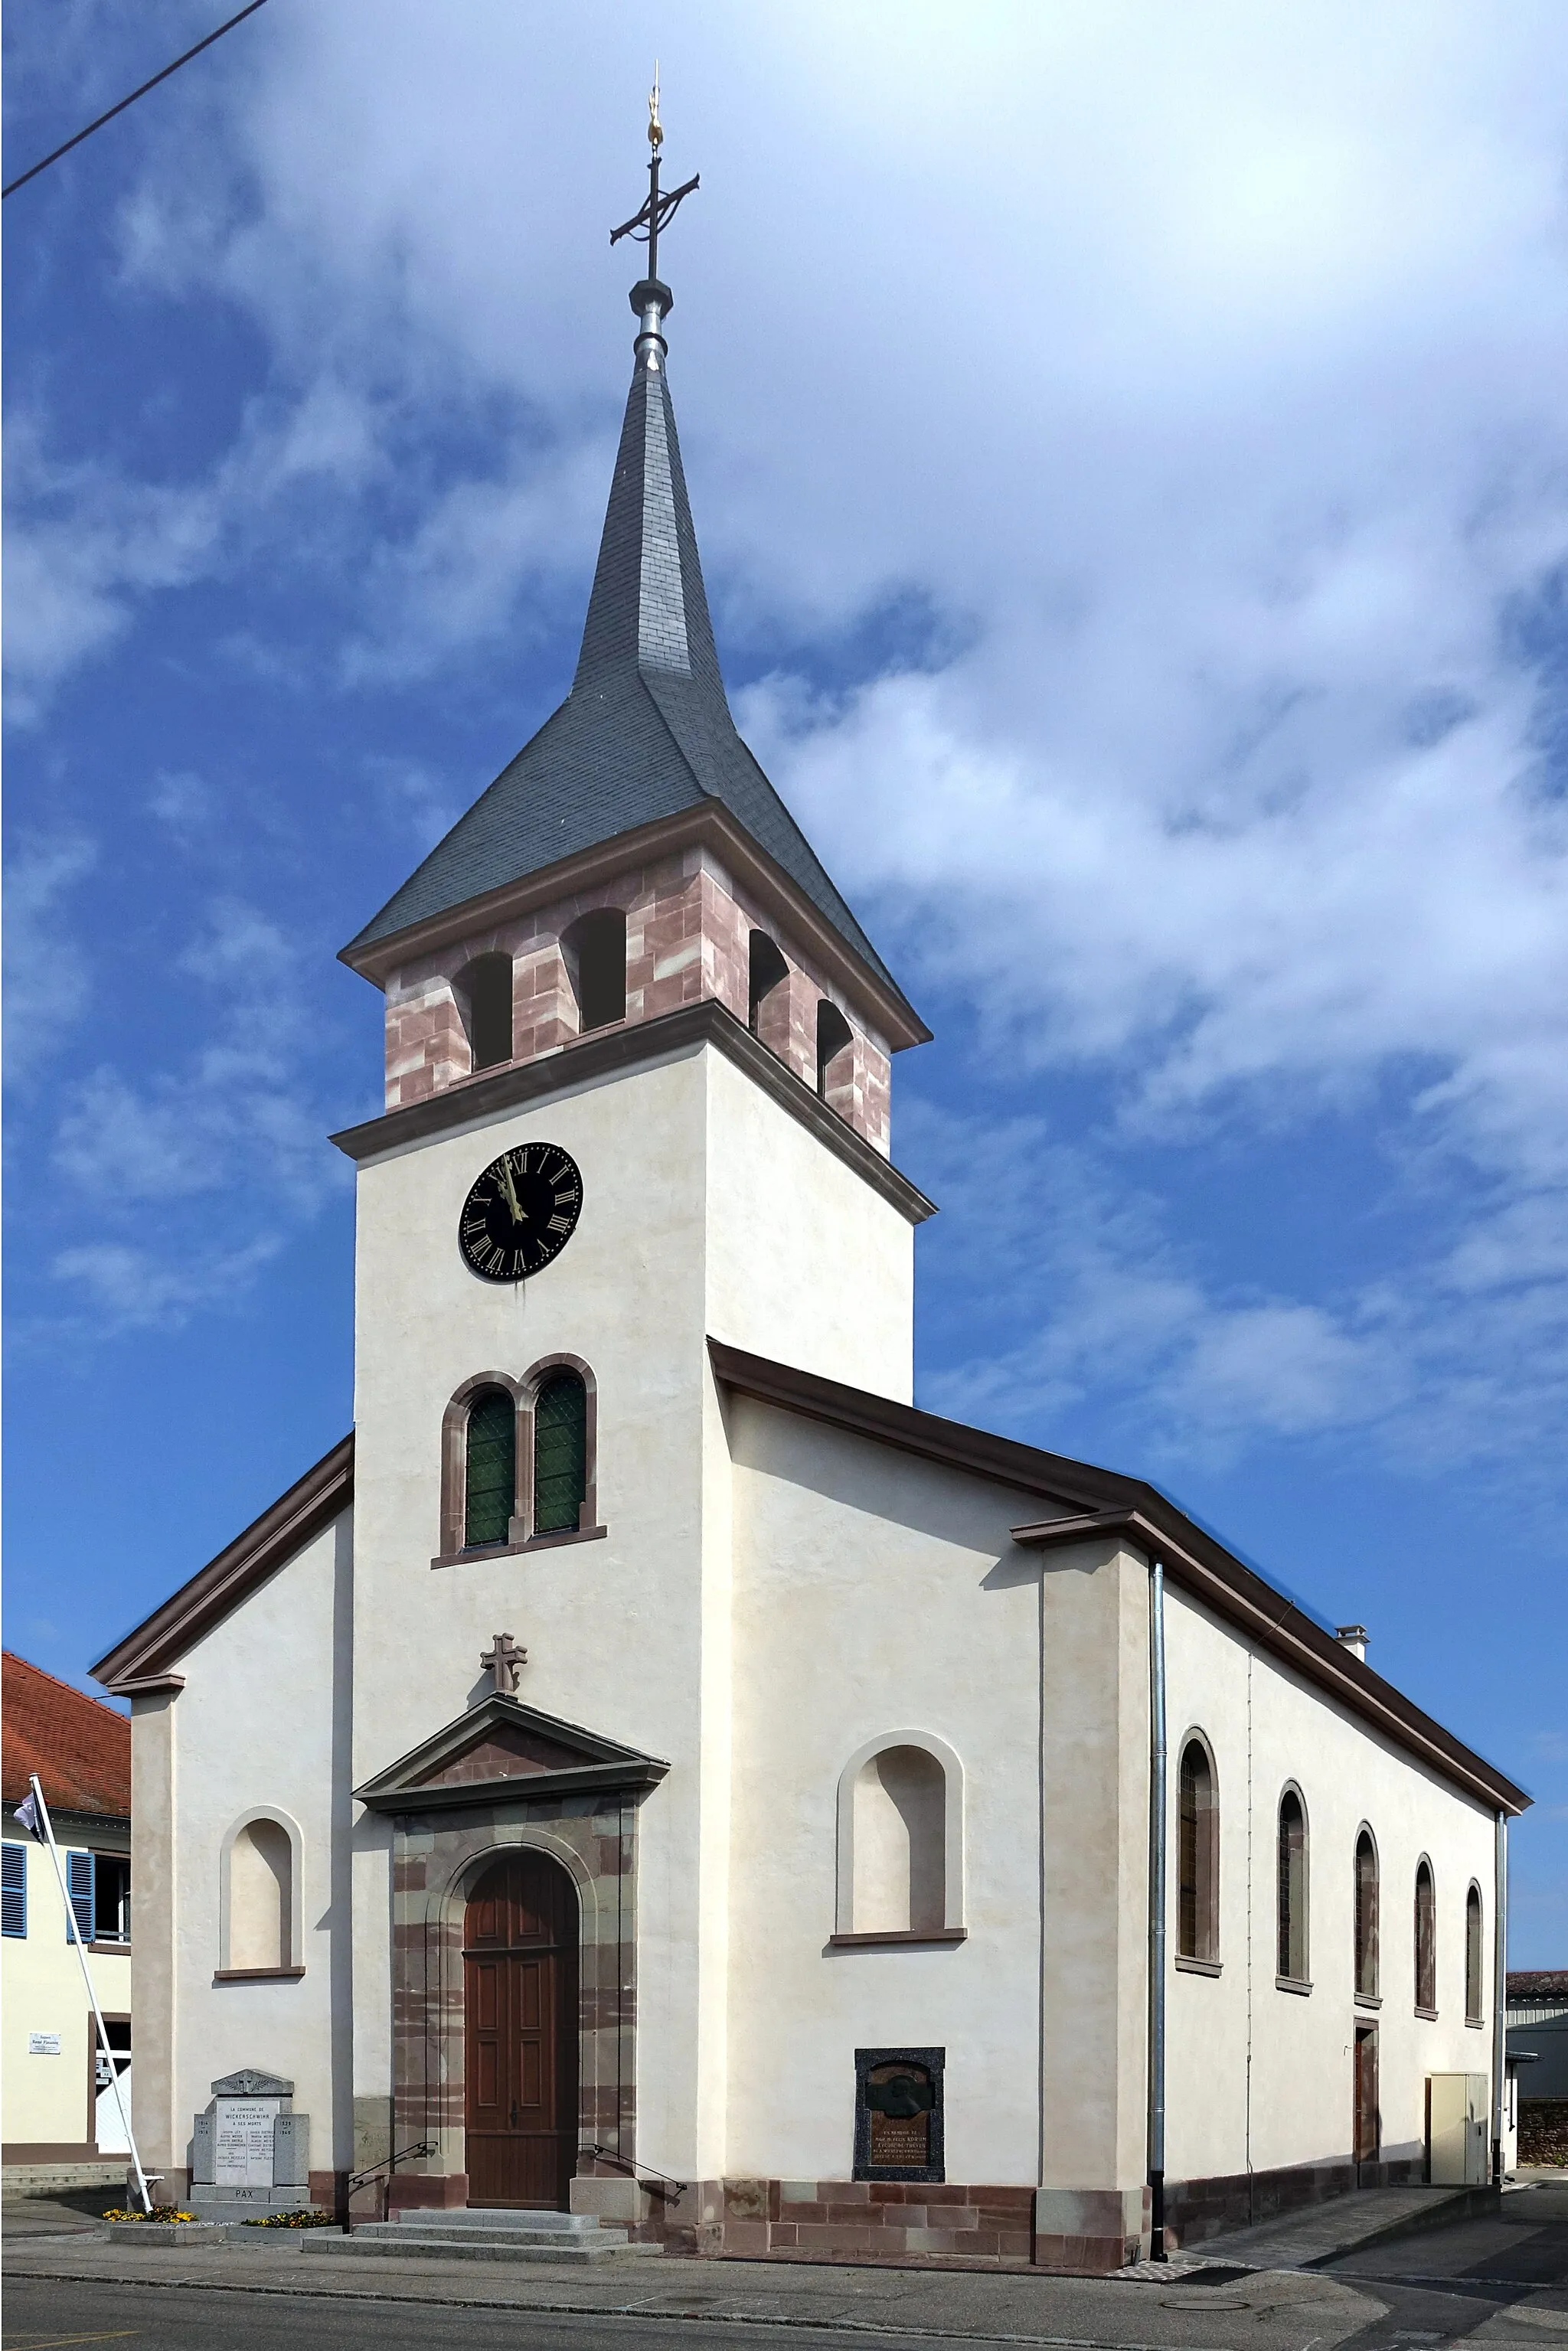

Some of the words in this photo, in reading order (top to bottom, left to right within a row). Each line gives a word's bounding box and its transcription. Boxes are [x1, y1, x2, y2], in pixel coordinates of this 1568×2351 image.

[512, 1151, 529, 1176] XII
[536, 1151, 550, 1174] I
[548, 1164, 570, 1186] II
[554, 1189, 575, 1206] III
[236, 2189, 253, 2198] PAX
